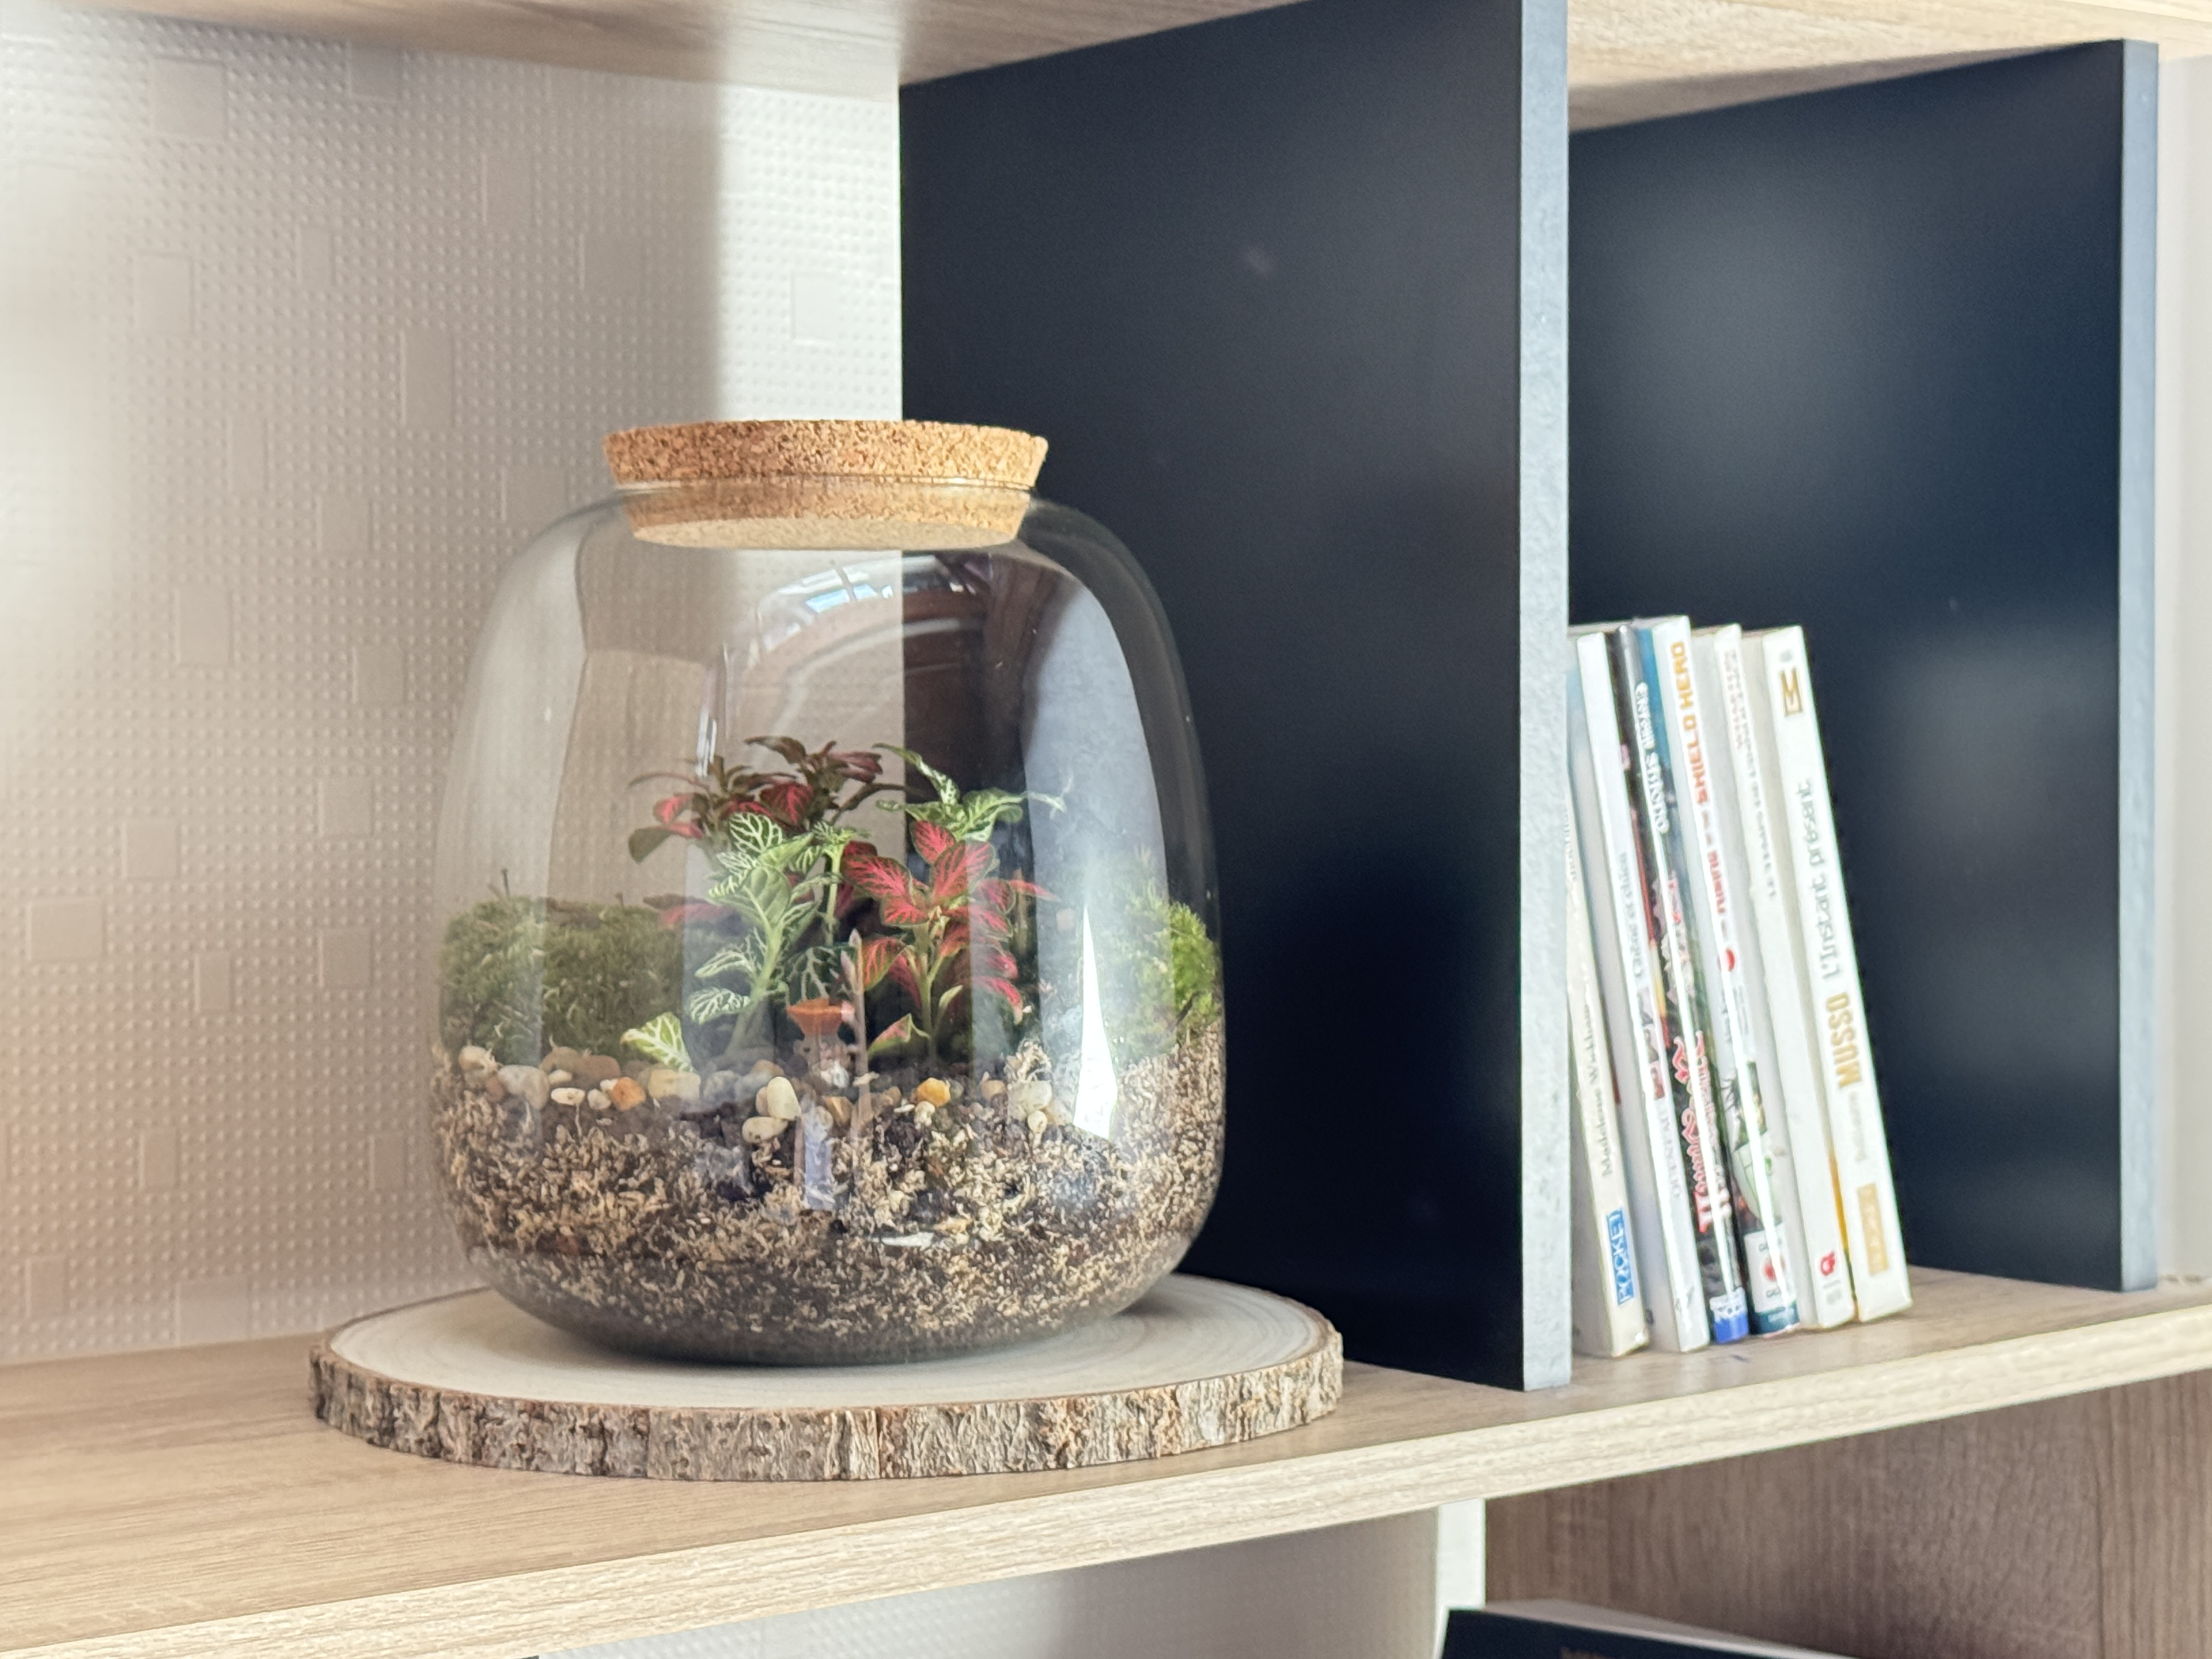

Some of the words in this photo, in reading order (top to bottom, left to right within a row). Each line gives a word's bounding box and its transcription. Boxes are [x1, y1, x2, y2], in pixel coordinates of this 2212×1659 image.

[1671, 641, 1694, 710] HERO
[1682, 714, 1709, 805] SHIELD
[1796, 779, 1824, 866] présent
[1826, 992, 1862, 1088] MUSSO
[1607, 1209, 1634, 1305] POCKET
